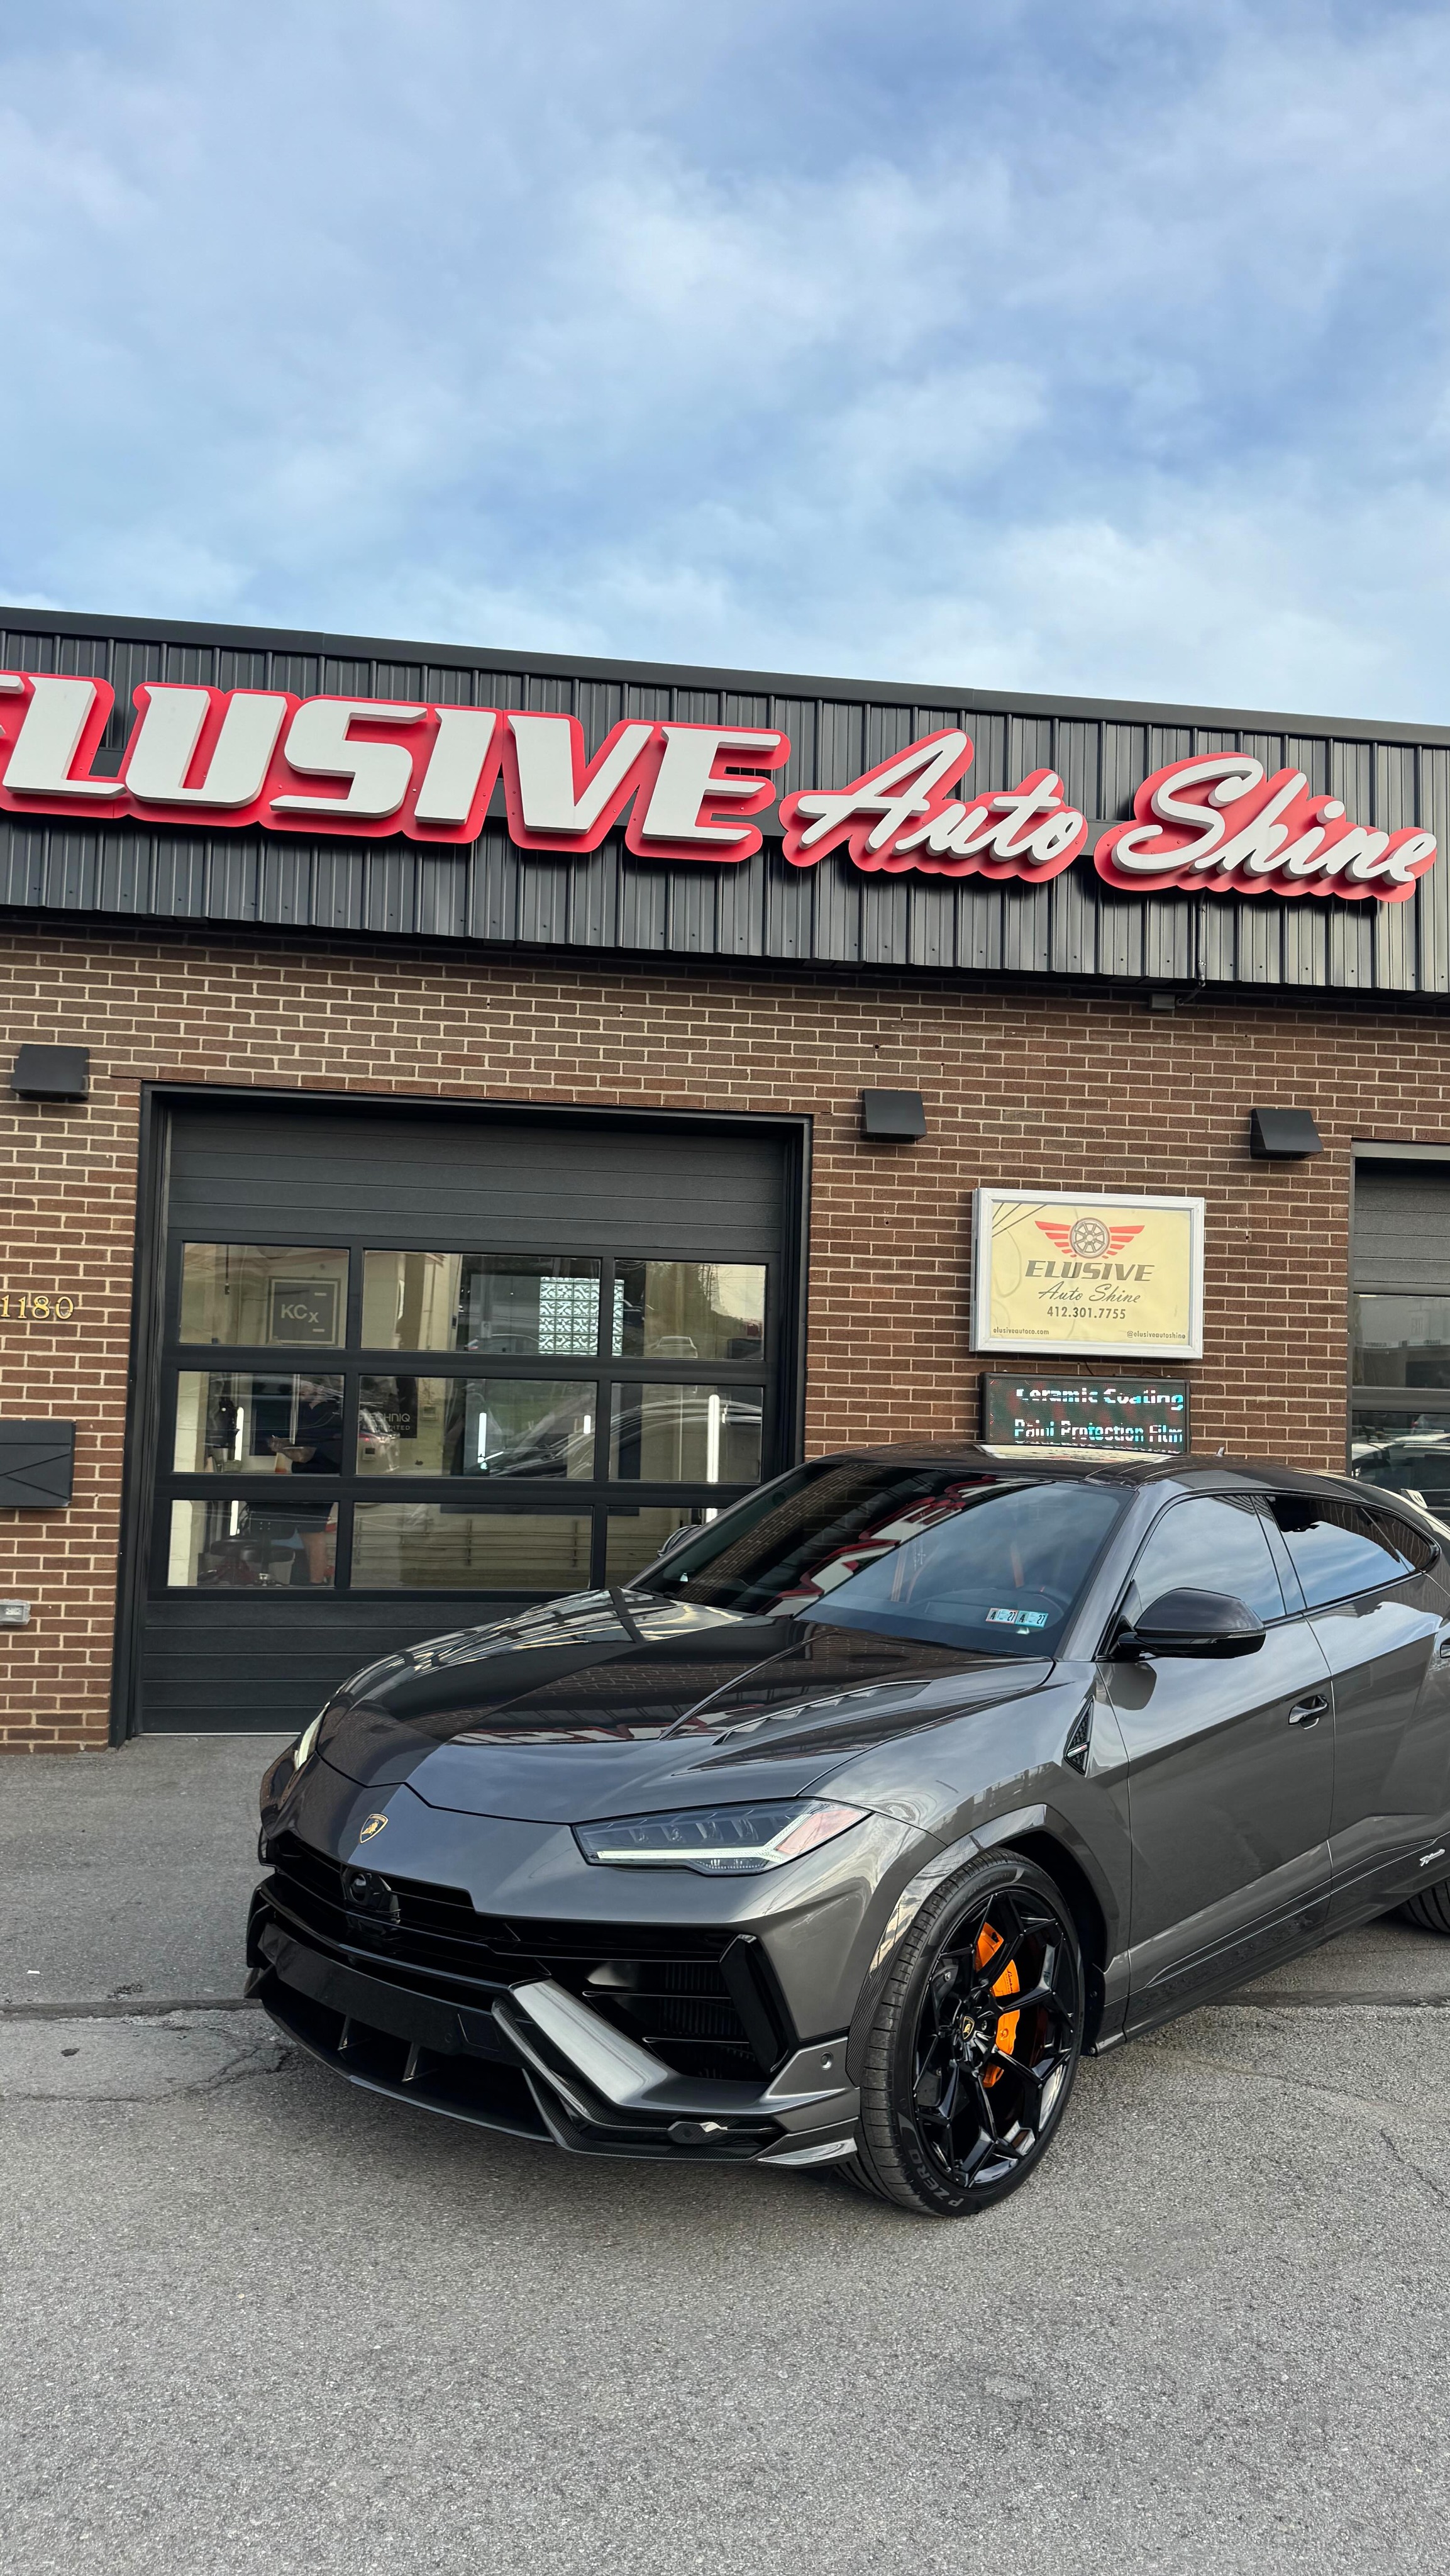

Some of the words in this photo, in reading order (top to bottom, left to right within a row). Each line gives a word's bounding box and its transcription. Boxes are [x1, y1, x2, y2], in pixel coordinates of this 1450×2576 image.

[796, 728, 1086, 866] Auto
[1111, 752, 1437, 886] Shine
[1025, 1260, 1155, 1282] ELUSIVE
[1038, 1280, 1083, 1300] Auto
[1088, 1283, 1141, 1303] Shine
[1, 1294, 74, 1319] 1180
[1047, 1306, 1126, 1319] 412.301.7755
[993, 1327, 1049, 1336] elusiveautoco.com
[1127, 1330, 1186, 1340] @elusiveautoshine
[1104, 1388, 1183, 1411] Coating
[1149, 1424, 1183, 1443] Film
[990, 1611, 996, 1619] 4
[1007, 1611, 1016, 1621] 27
[1019, 1614, 1026, 1623] 4
[1036, 1614, 1046, 1624] 27
[908, 2148, 950, 2201] ZERO
[948, 2197, 965, 2207] P
